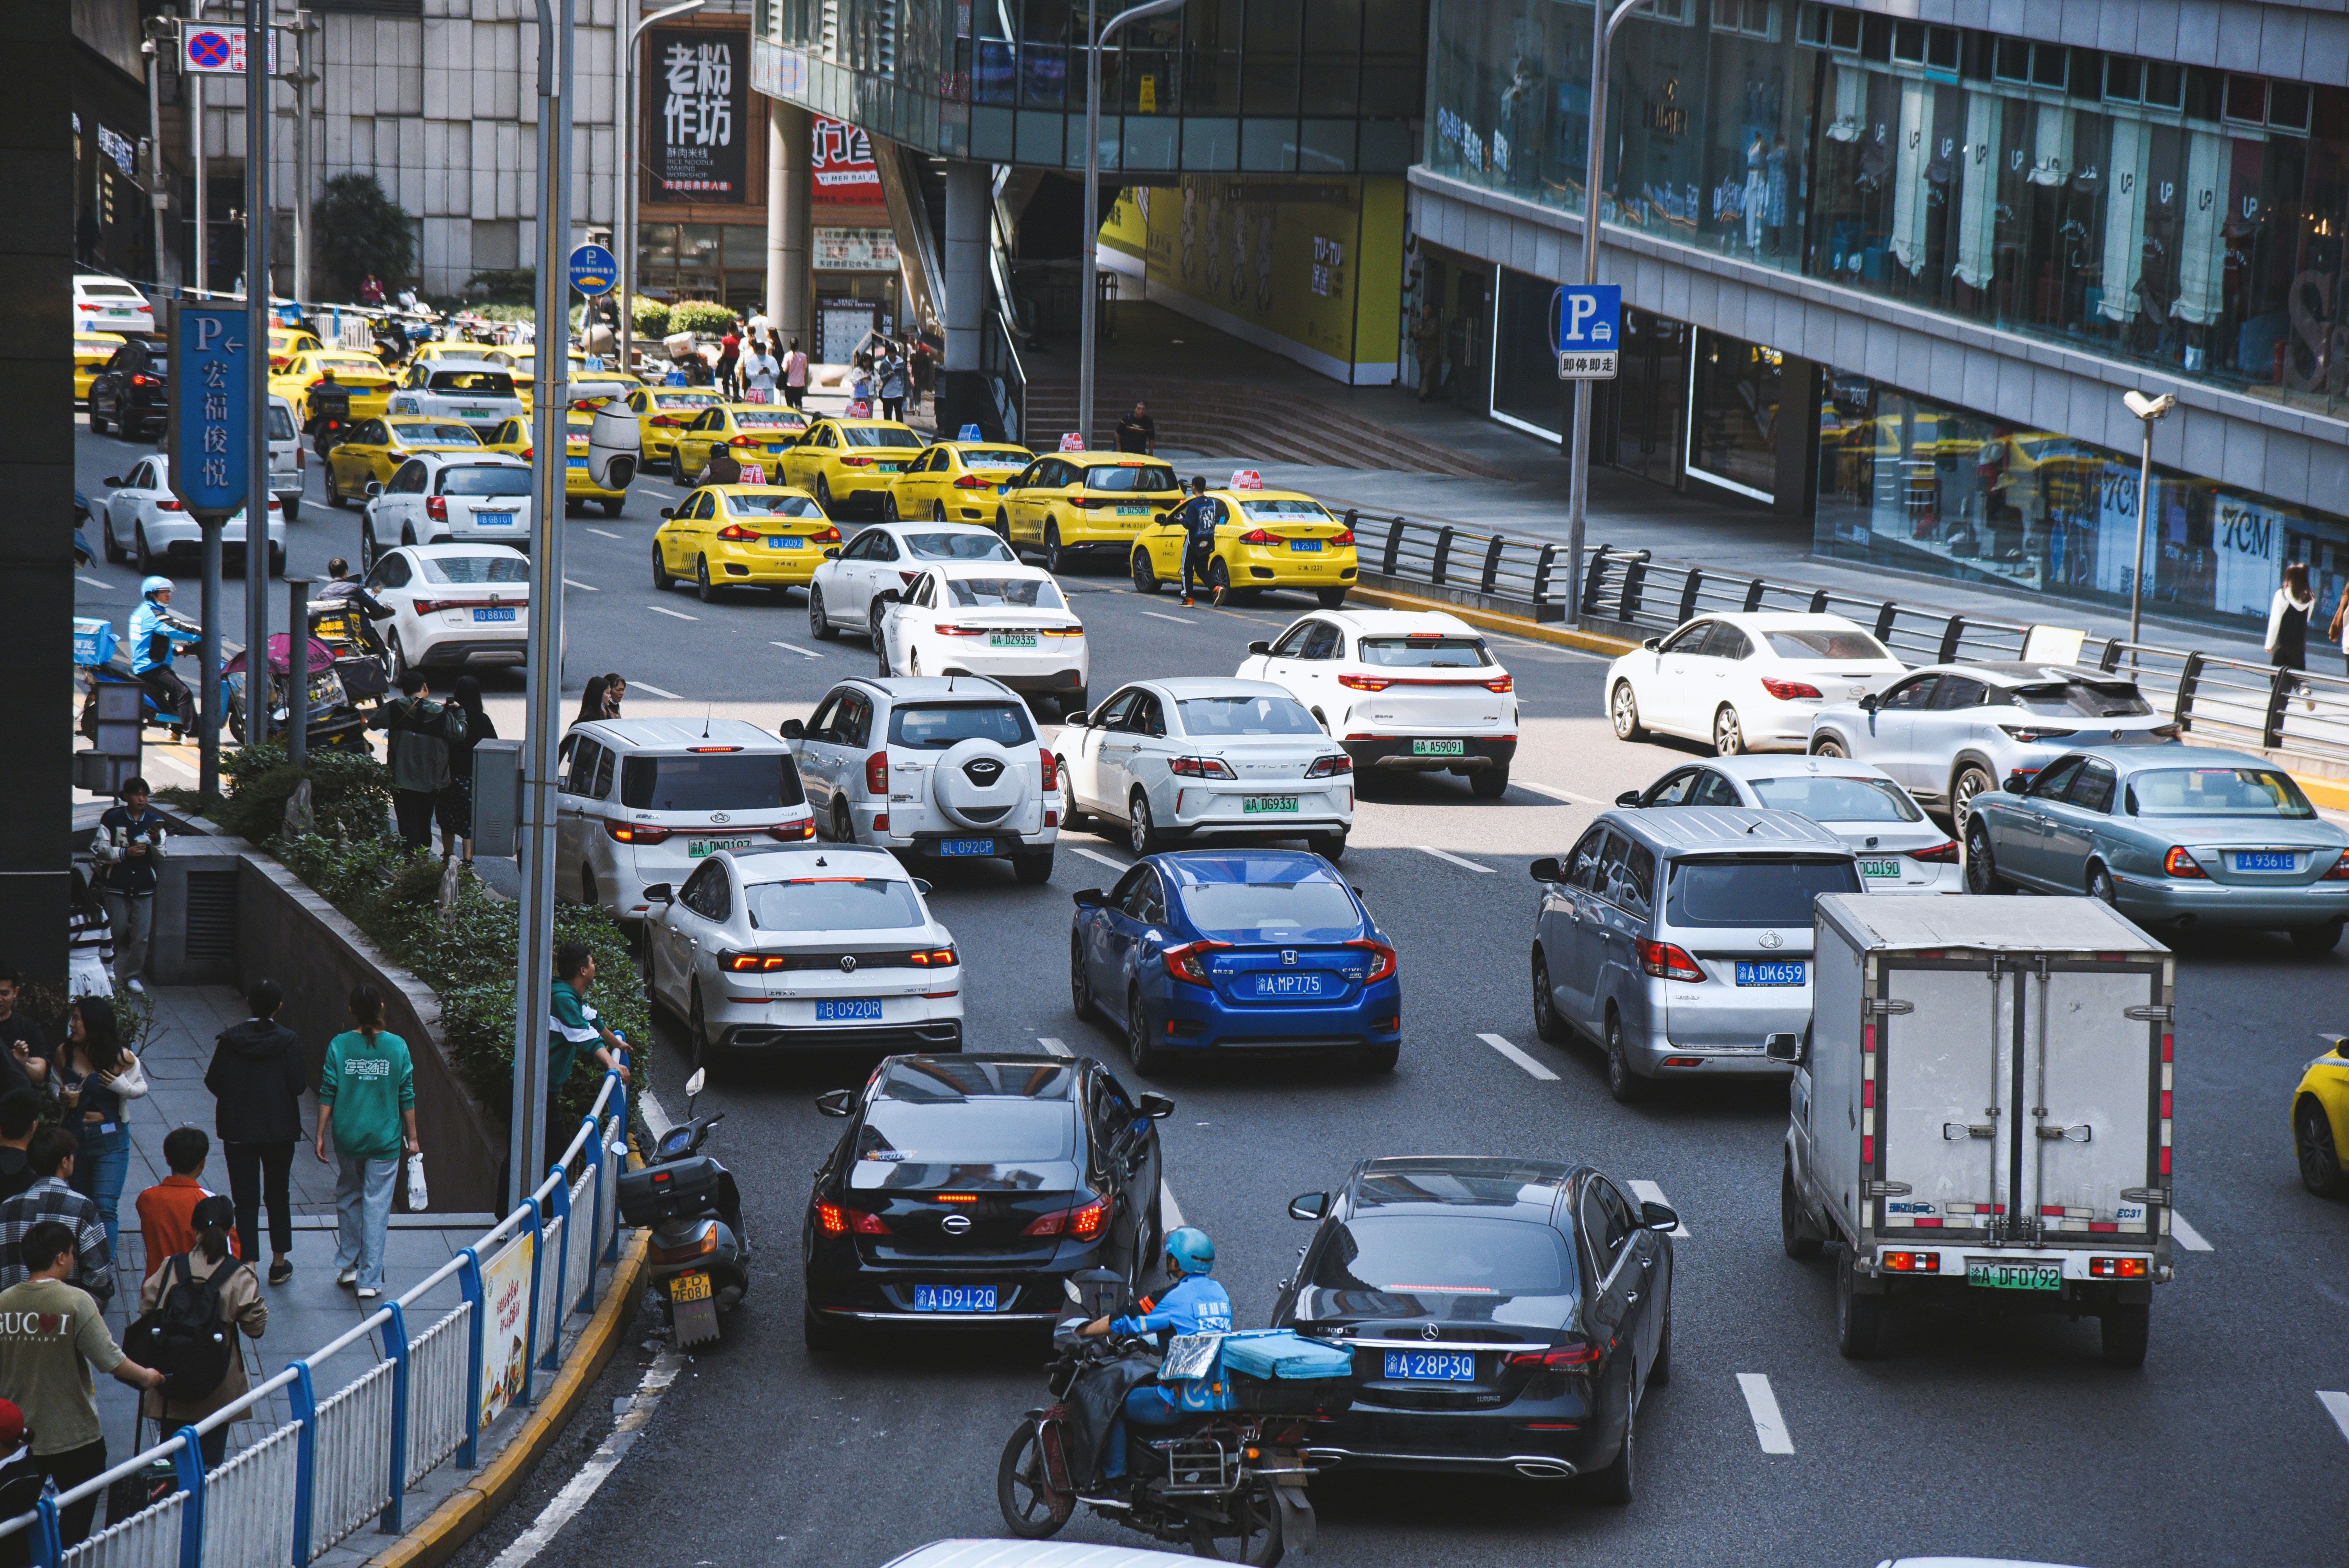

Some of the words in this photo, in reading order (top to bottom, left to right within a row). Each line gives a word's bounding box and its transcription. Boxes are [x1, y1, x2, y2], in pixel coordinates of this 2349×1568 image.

[664, 43, 731, 95] 老粉
[664, 96, 731, 146] 作坊
[667, 148, 708, 158] 酥肉米线
[587, 250, 596, 264] P
[194, 317, 223, 350] P
[1567, 295, 1597, 340] P
[1563, 358, 1614, 372] 即停即走
[202, 360, 229, 487] 宏福俊悦
[2222, 505, 2272, 560] 7CM
[2117, 1208, 2141, 1218] EC31
